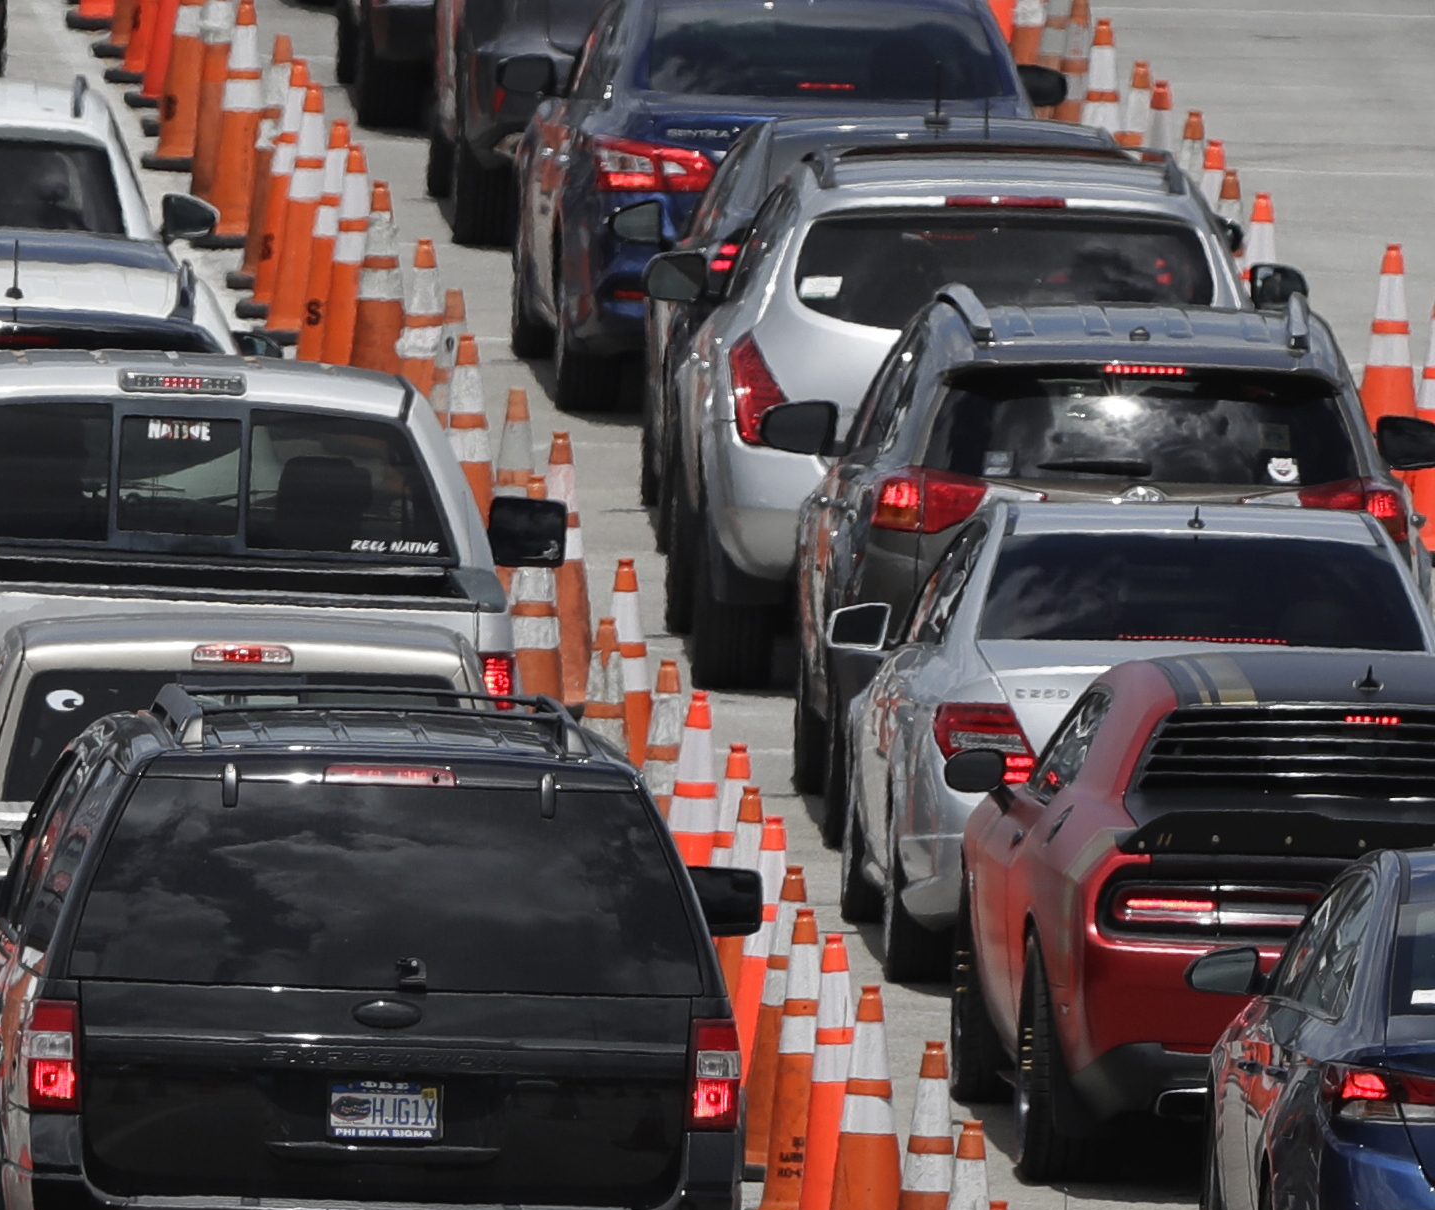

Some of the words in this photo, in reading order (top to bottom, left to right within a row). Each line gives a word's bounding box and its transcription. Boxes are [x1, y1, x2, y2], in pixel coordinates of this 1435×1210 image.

[666, 128, 731, 139] SENTRA
[390, 539, 440, 554] NATIVE
[262, 1049, 509, 1068] EXPEDITION
[372, 1096, 436, 1126] HJG1X
[334, 1128, 356, 1137] PHI
[358, 1129, 390, 1137] BETA
[391, 1129, 433, 1138] SIGMA
